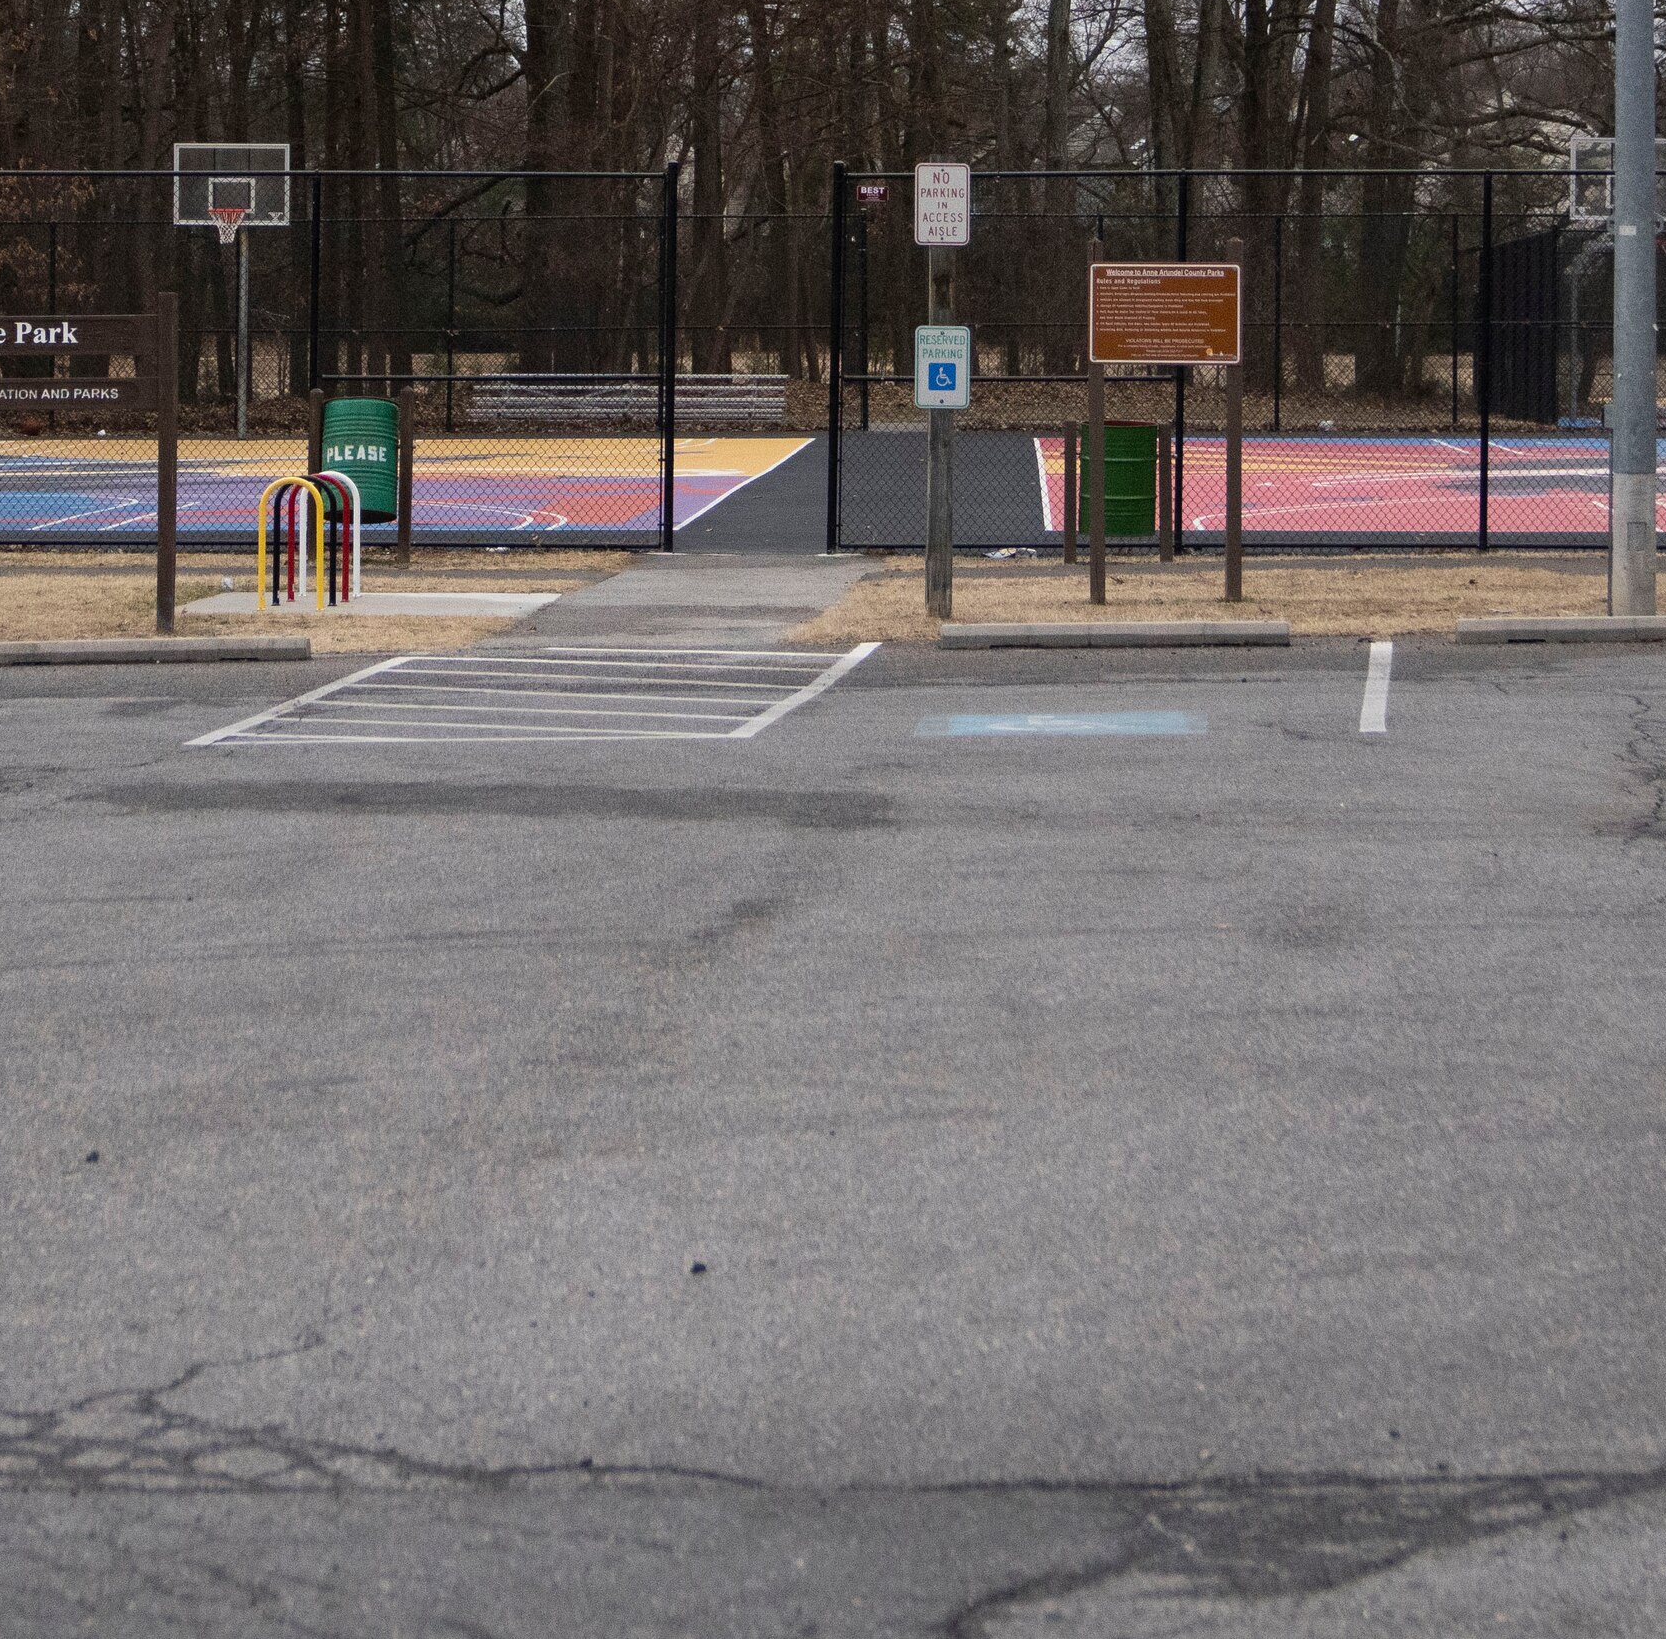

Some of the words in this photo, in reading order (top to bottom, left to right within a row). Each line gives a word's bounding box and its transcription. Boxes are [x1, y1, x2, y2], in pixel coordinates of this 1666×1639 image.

[933, 172, 950, 185] NO
[860, 186, 885, 194] BEST
[920, 188, 965, 199] PARKING
[922, 212, 964, 223] ACCESS
[928, 226, 958, 237] AISLE
[1184, 269, 1206, 277] County
[13, 322, 79, 345] Park
[919, 335, 966, 345] RESERVED
[922, 348, 963, 359] PARKING
[41, 388, 69, 399] AND
[73, 388, 119, 399] PARKS
[326, 444, 388, 462] PLEASE
